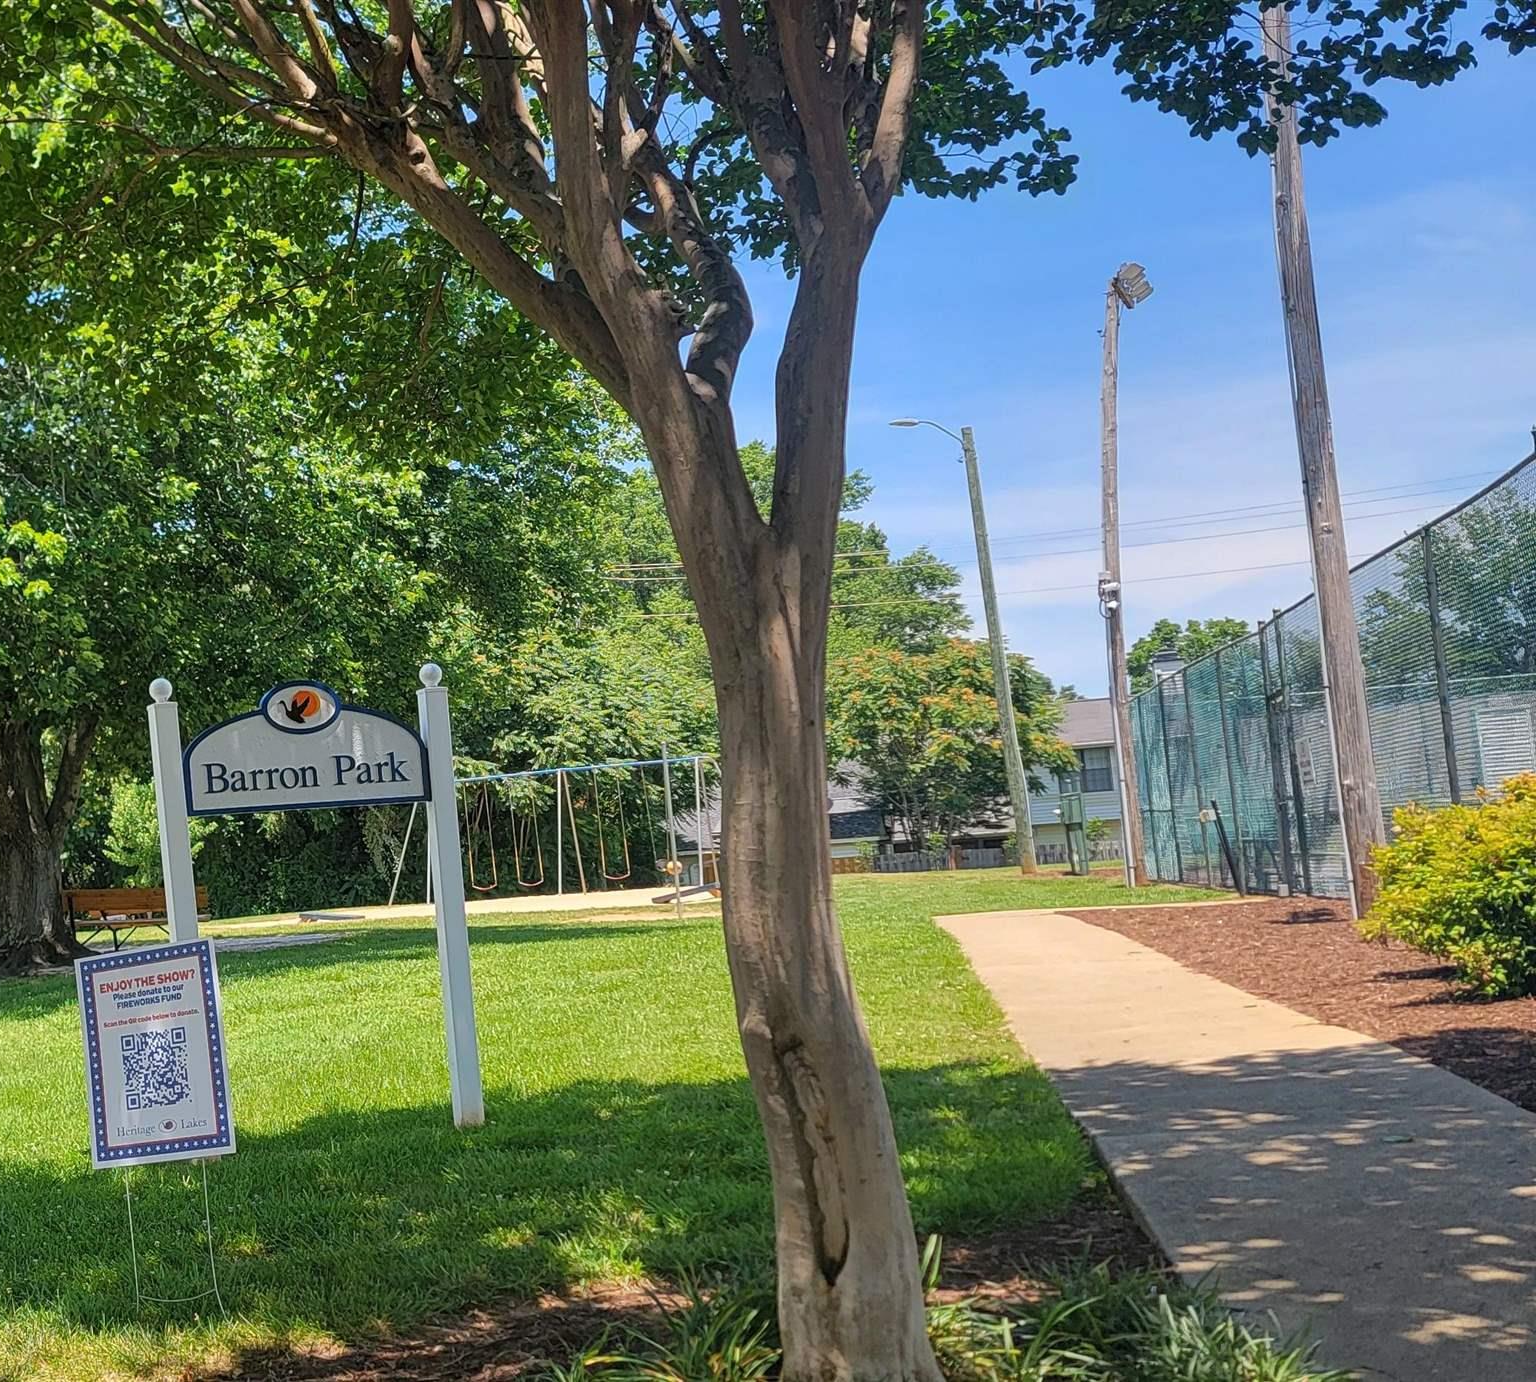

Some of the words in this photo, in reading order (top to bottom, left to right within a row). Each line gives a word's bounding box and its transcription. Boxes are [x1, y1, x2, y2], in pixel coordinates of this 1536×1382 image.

[203, 762, 319, 794] Barron
[330, 751, 410, 787] Park
[99, 980, 133, 994] ENJOY
[134, 975, 155, 987] THE
[157, 969, 195, 984] SHOW?
[112, 992, 137, 1001] Please
[137, 987, 162, 997] donate
[163, 985, 171, 993] to
[116, 996, 161, 1009] FIREWORKS
[161, 992, 182, 1003] FUND
[103, 1020, 118, 1028] Scan
[118, 1018, 128, 1026] the
[128, 1016, 137, 1024] QR
[137, 1014, 152, 1023] code
[152, 1012, 170, 1021] below
[117, 1124, 156, 1137] Heritage
[181, 1117, 208, 1129] Lakes
